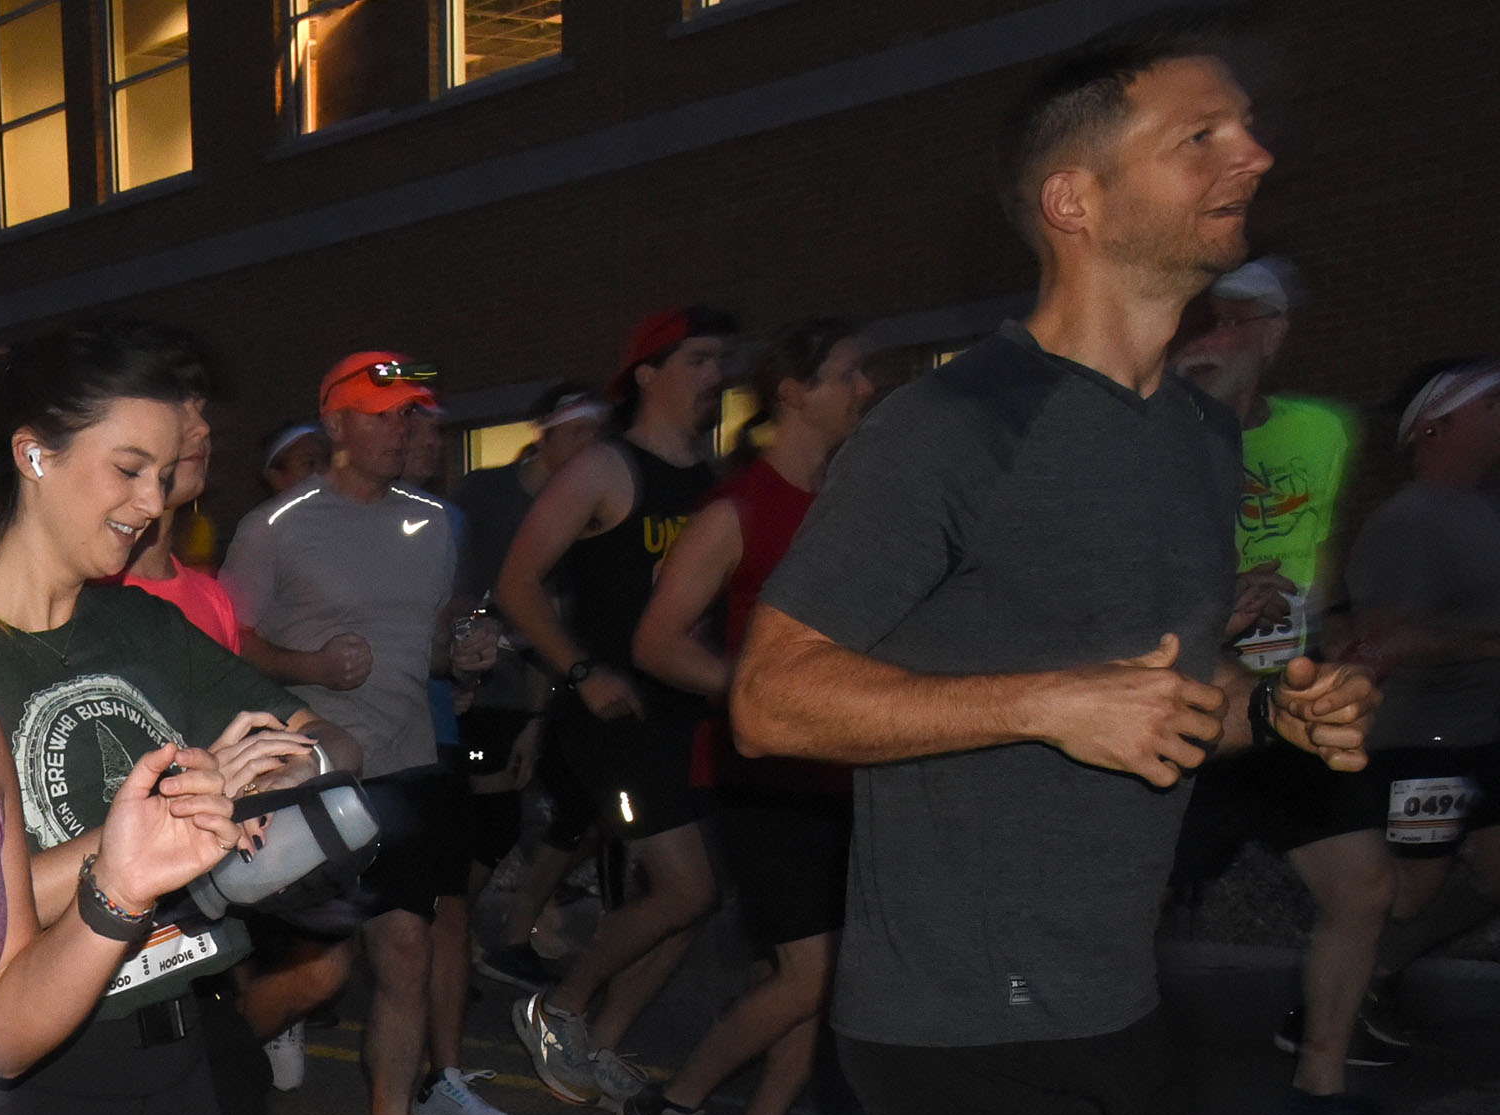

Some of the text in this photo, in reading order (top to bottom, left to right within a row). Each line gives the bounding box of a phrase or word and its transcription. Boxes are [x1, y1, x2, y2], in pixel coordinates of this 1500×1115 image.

[46, 713, 79, 799] BREWHA
[196, 935, 207, 953] 980
[140, 954, 151, 976] 1980
[158, 949, 195, 972] HOODIE
[107, 974, 132, 991] OOD
